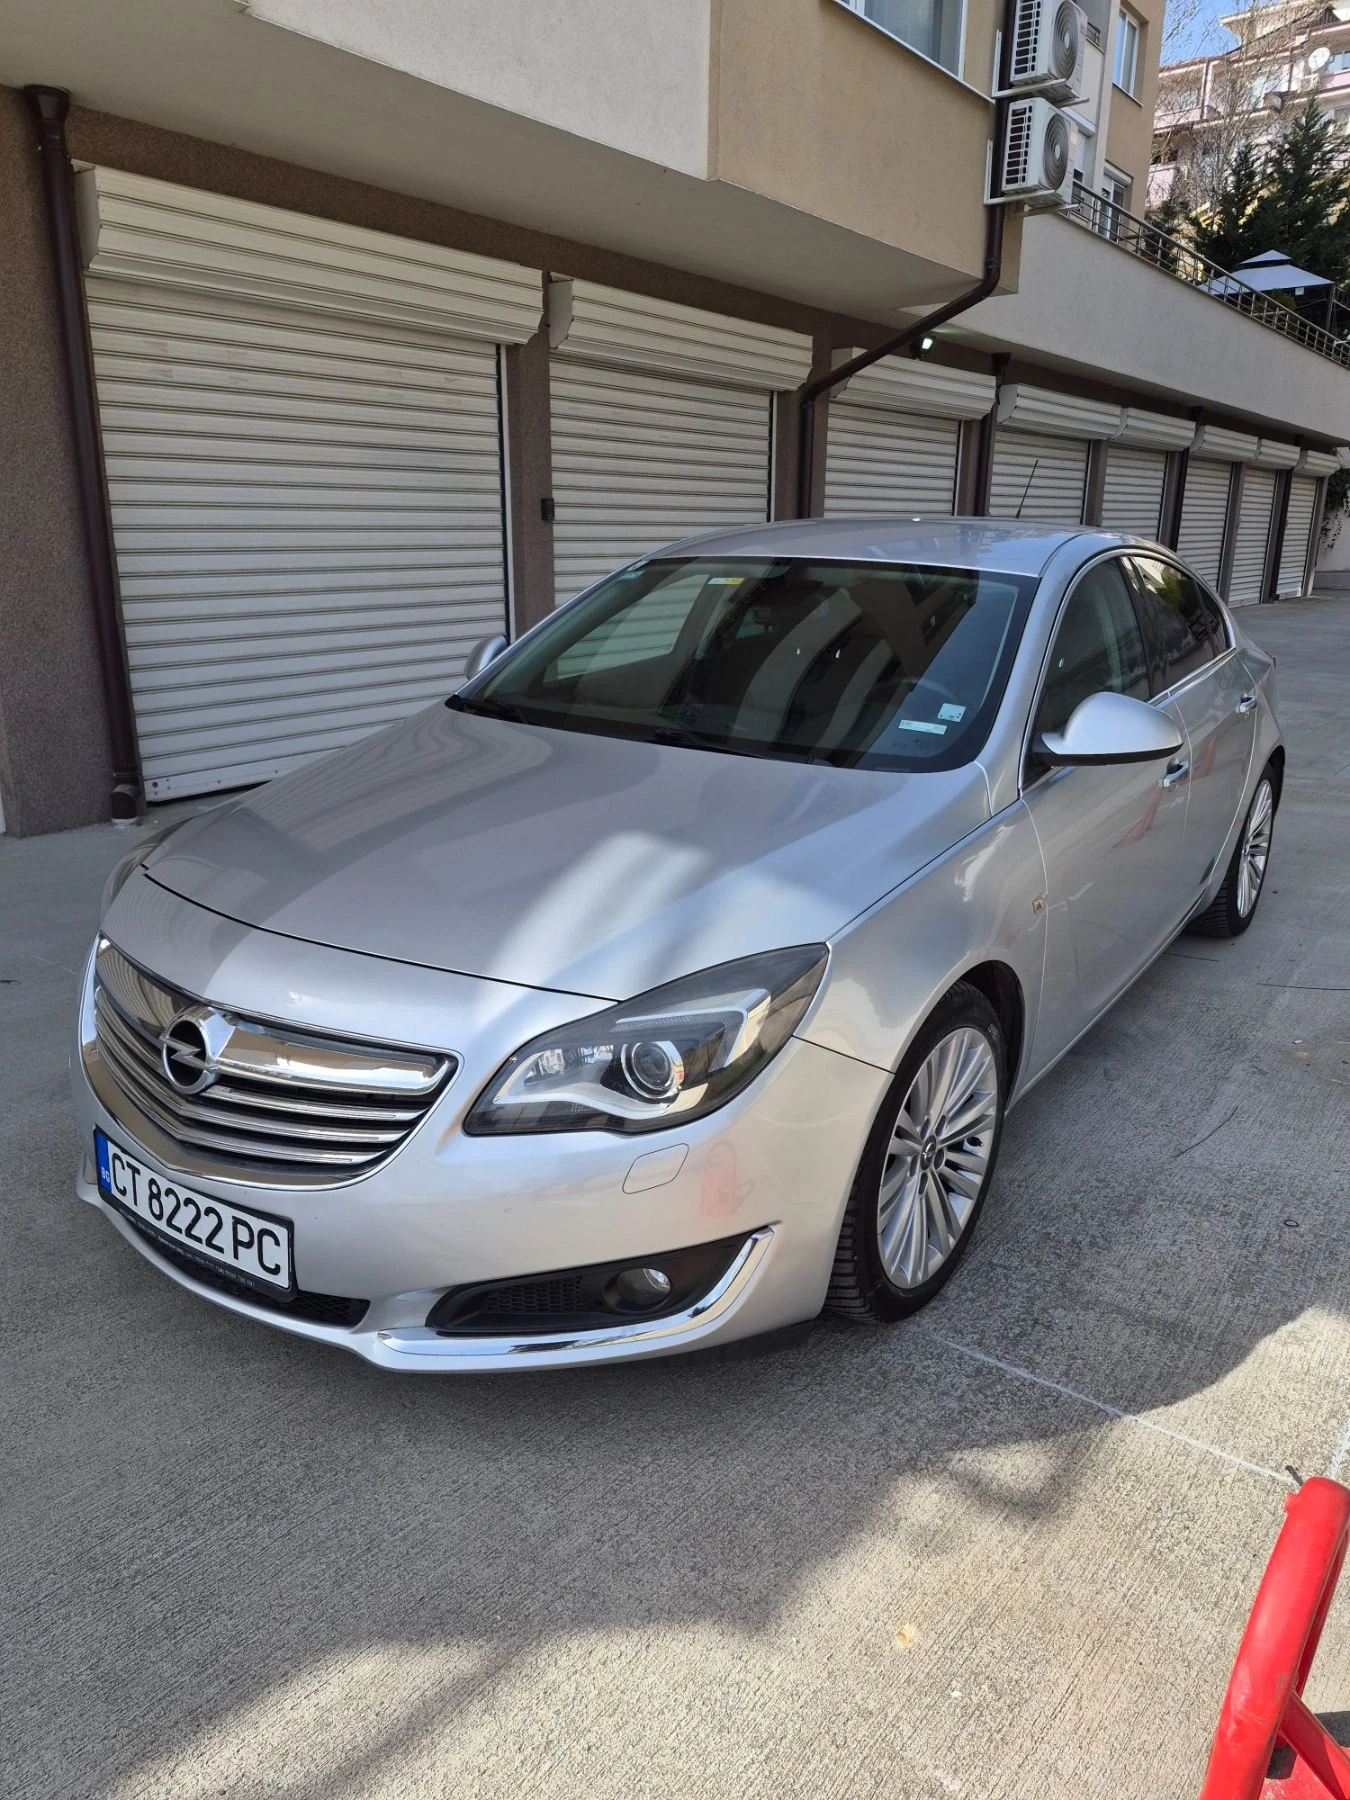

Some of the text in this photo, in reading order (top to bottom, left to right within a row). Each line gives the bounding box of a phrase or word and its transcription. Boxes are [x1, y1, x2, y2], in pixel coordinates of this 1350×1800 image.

[100, 1167, 111, 1183] BG
[112, 1152, 281, 1276] CT 8222 PC
